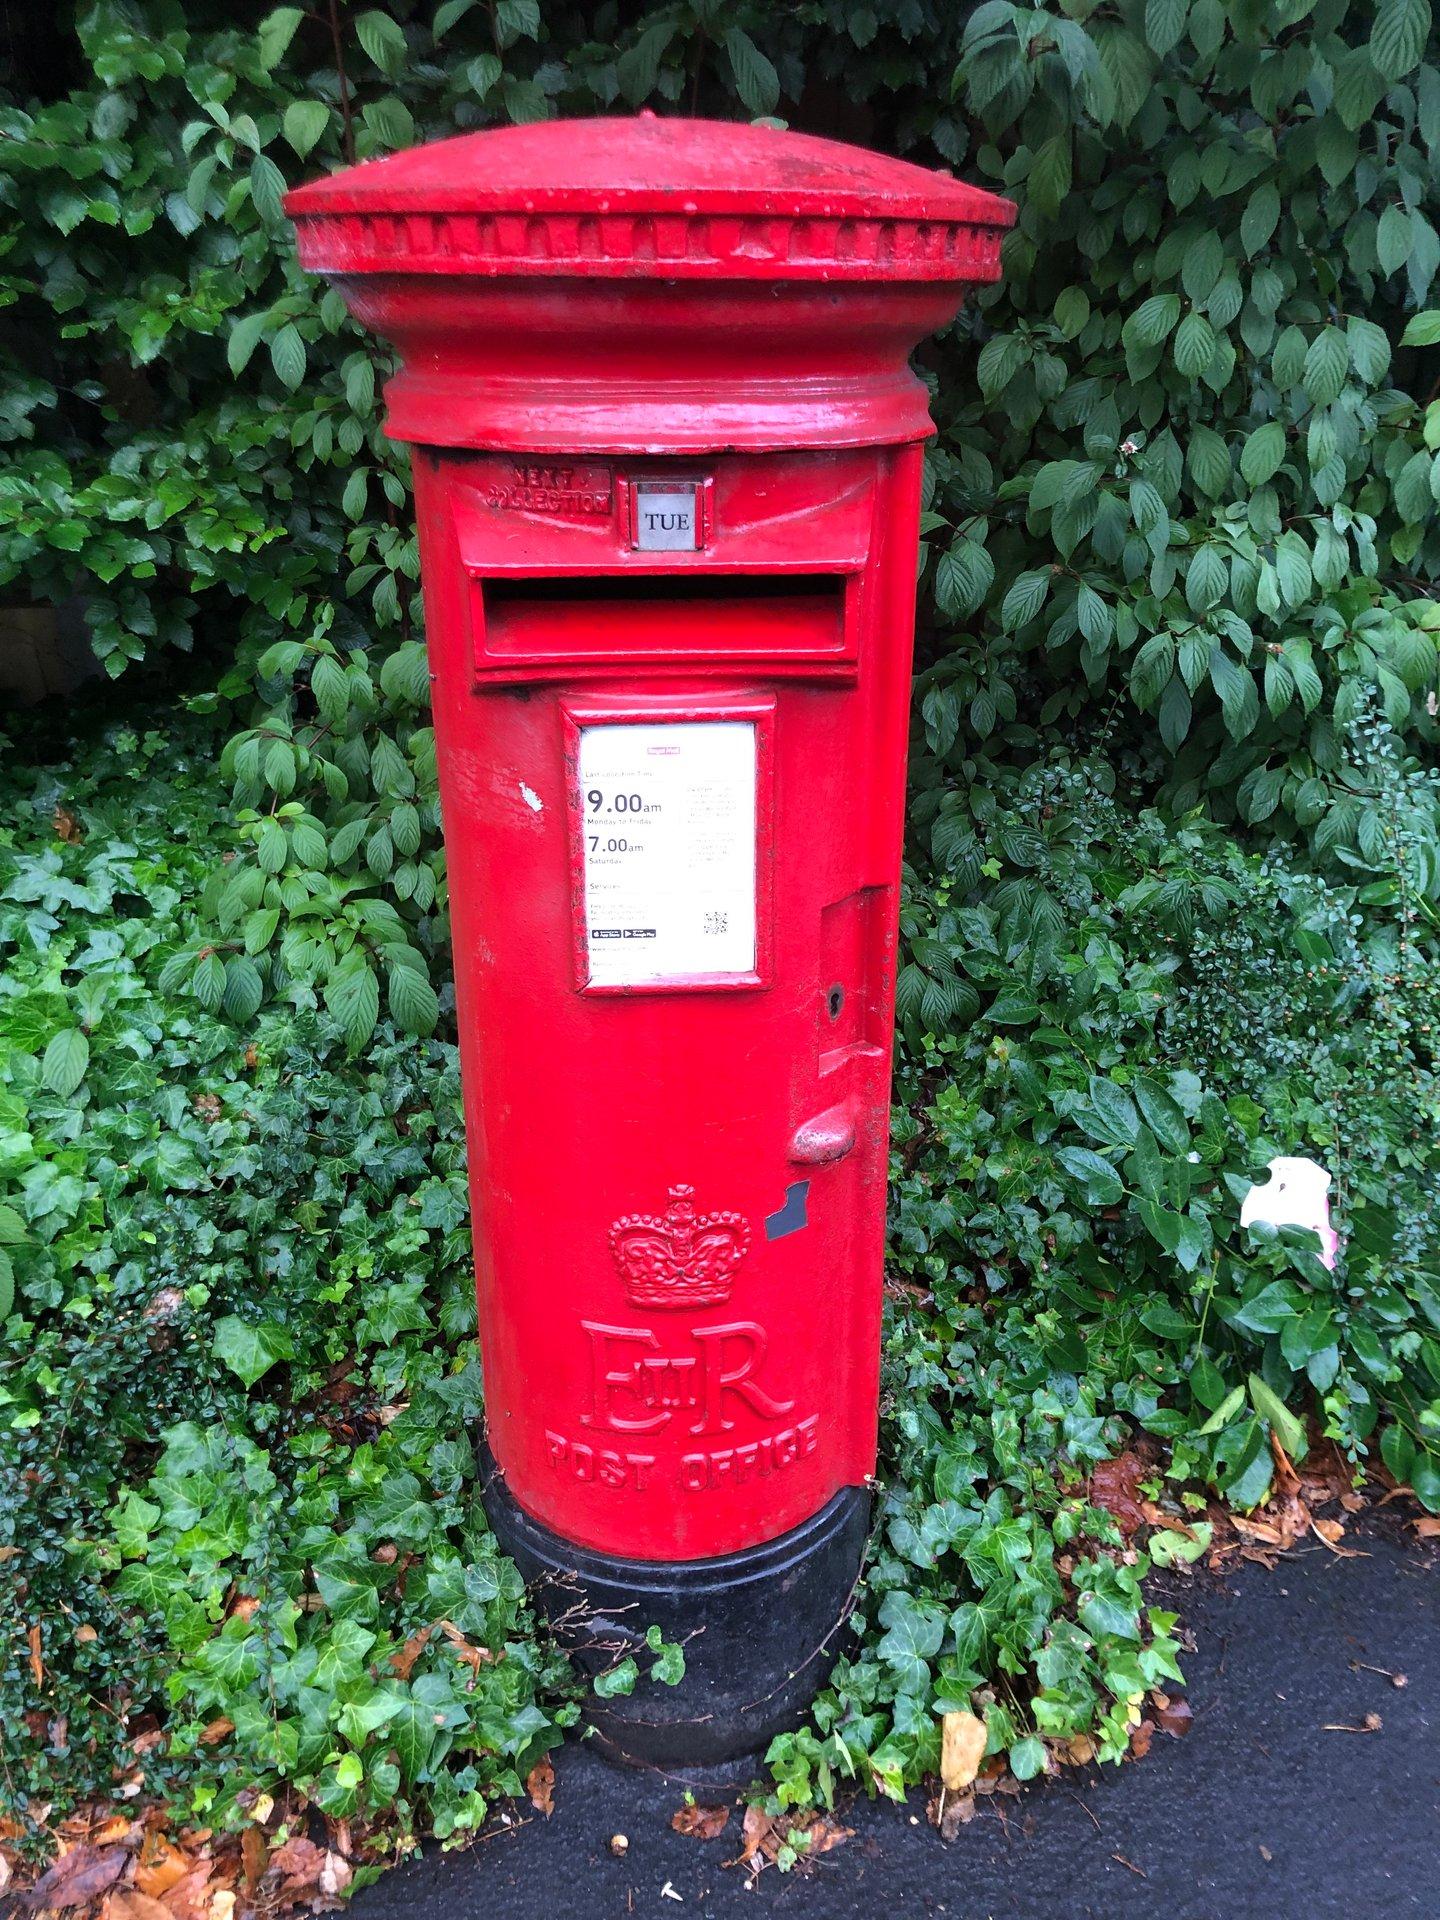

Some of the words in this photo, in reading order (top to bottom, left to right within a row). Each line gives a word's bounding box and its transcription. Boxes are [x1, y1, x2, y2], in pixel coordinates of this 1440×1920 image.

[645, 513, 690, 531] TUE
[544, 1428, 656, 1491] POST
[680, 1412, 821, 1491] OFFICE
